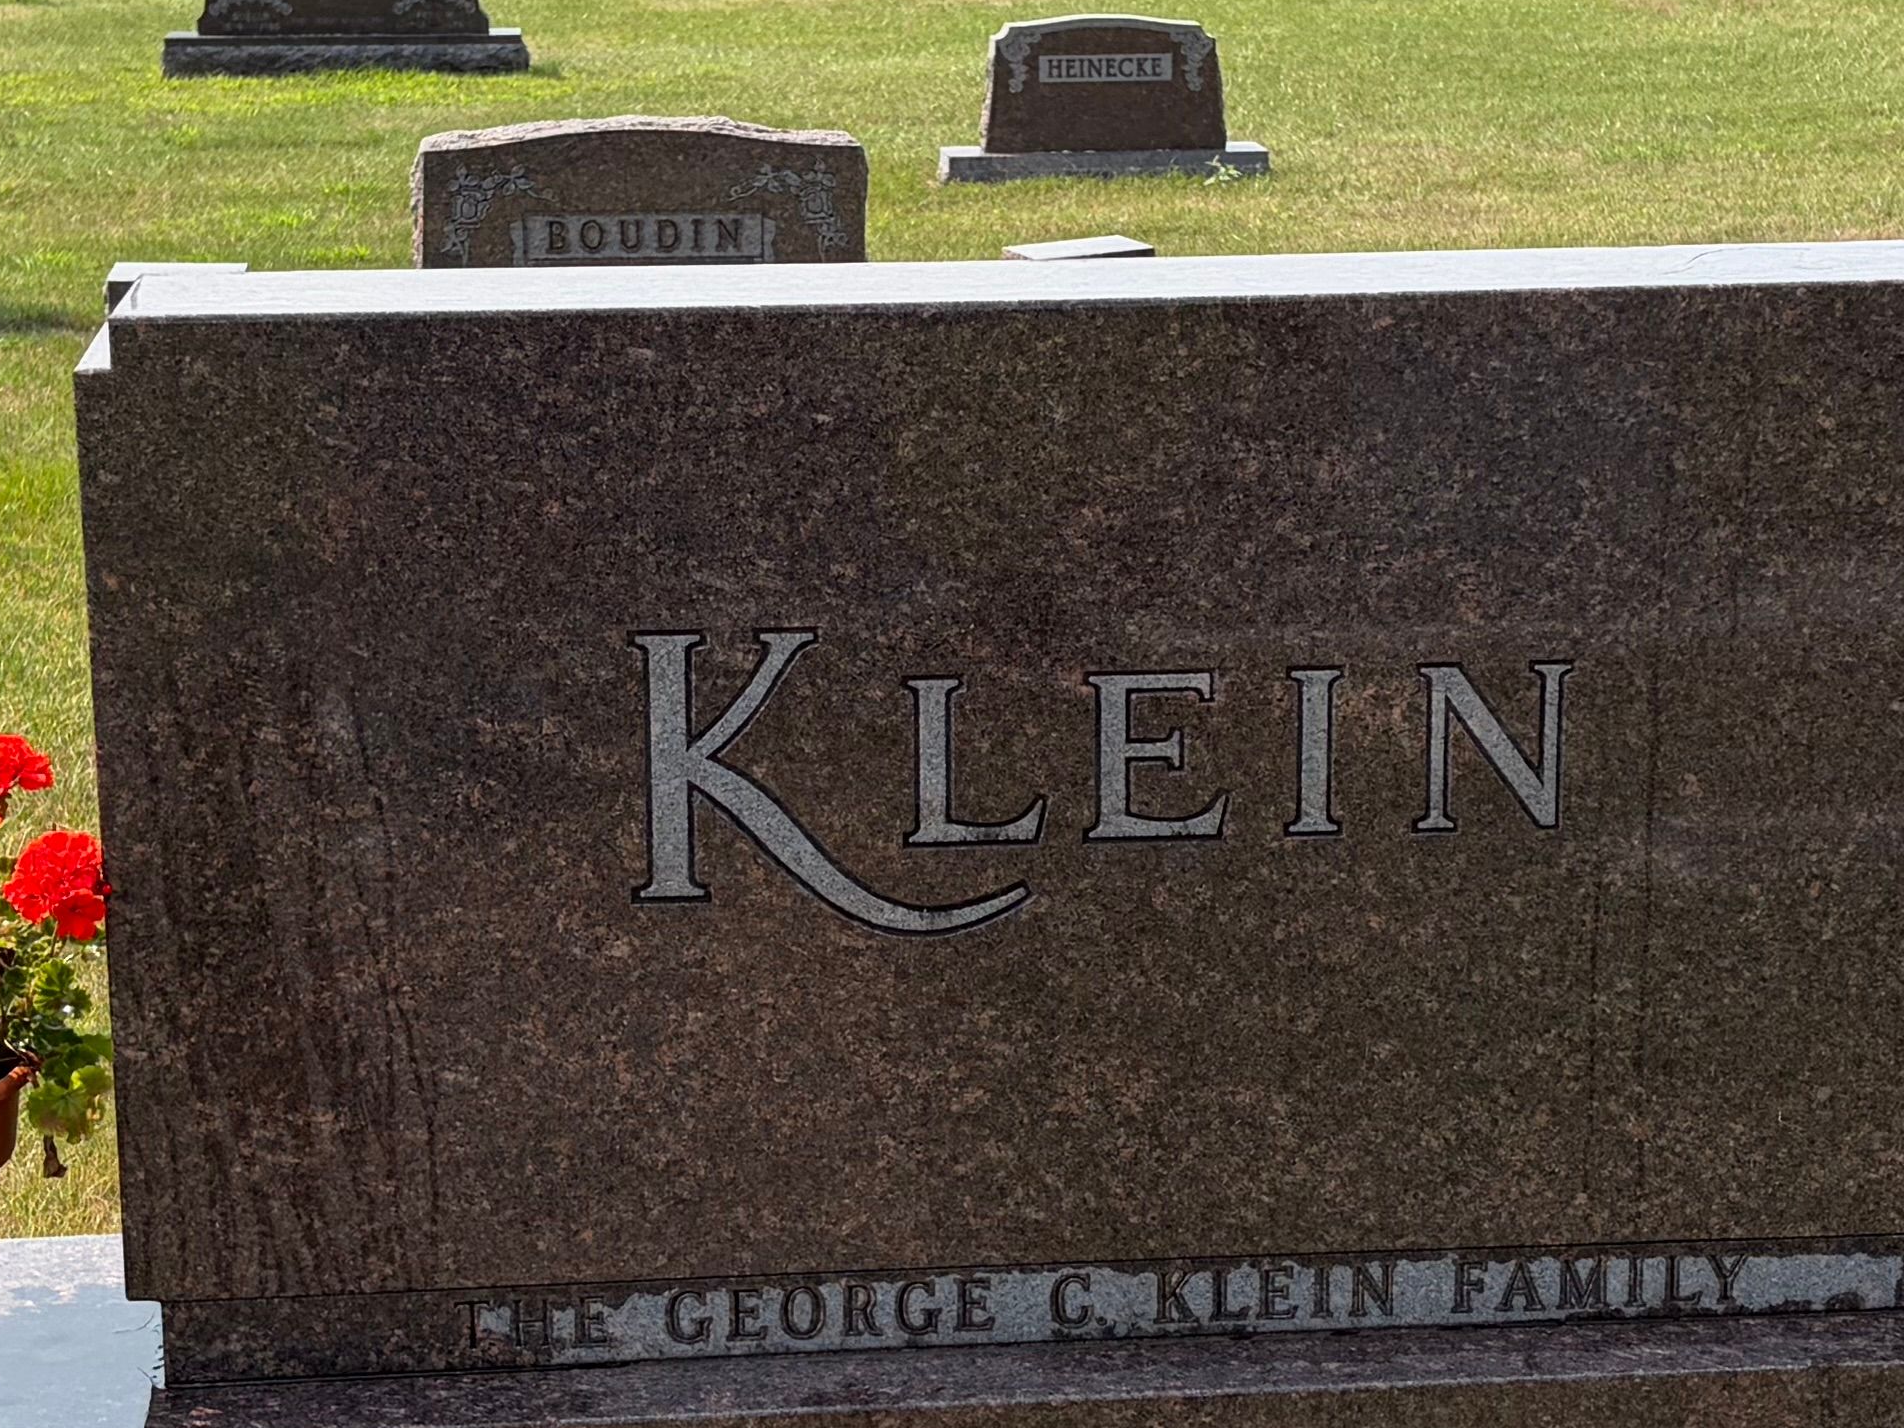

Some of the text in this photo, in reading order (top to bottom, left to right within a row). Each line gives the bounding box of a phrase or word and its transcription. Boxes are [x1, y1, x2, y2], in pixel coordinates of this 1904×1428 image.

[1047, 58, 1163, 78] HEINECKE
[547, 218, 742, 253] BOUDIN
[626, 625, 1573, 940] KLEIN
[454, 1253, 1755, 1351] THE GEORGE C. KLEIN FAMILY
